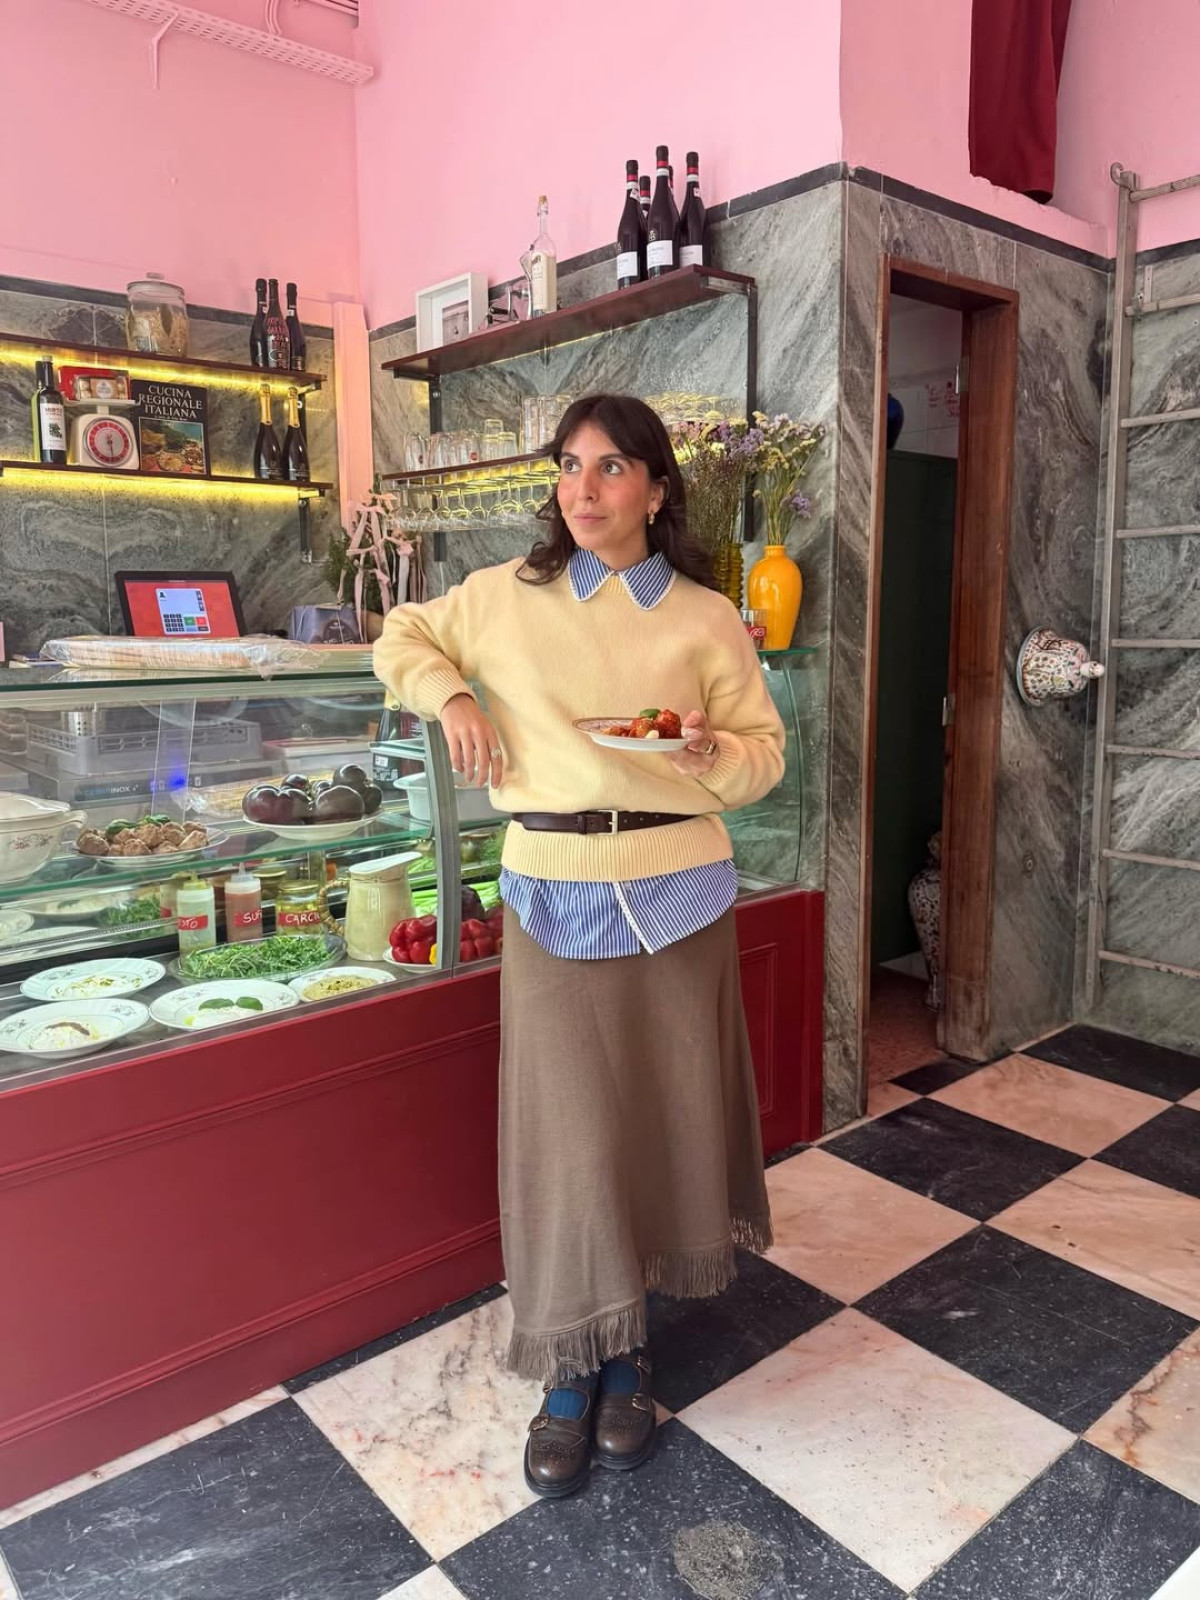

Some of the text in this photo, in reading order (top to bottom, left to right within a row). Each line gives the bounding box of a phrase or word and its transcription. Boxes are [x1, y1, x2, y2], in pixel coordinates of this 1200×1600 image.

[148, 385, 192, 399] CUCINA
[138, 393, 203, 410] REGIONALE
[144, 404, 197, 419] ITALIANA
